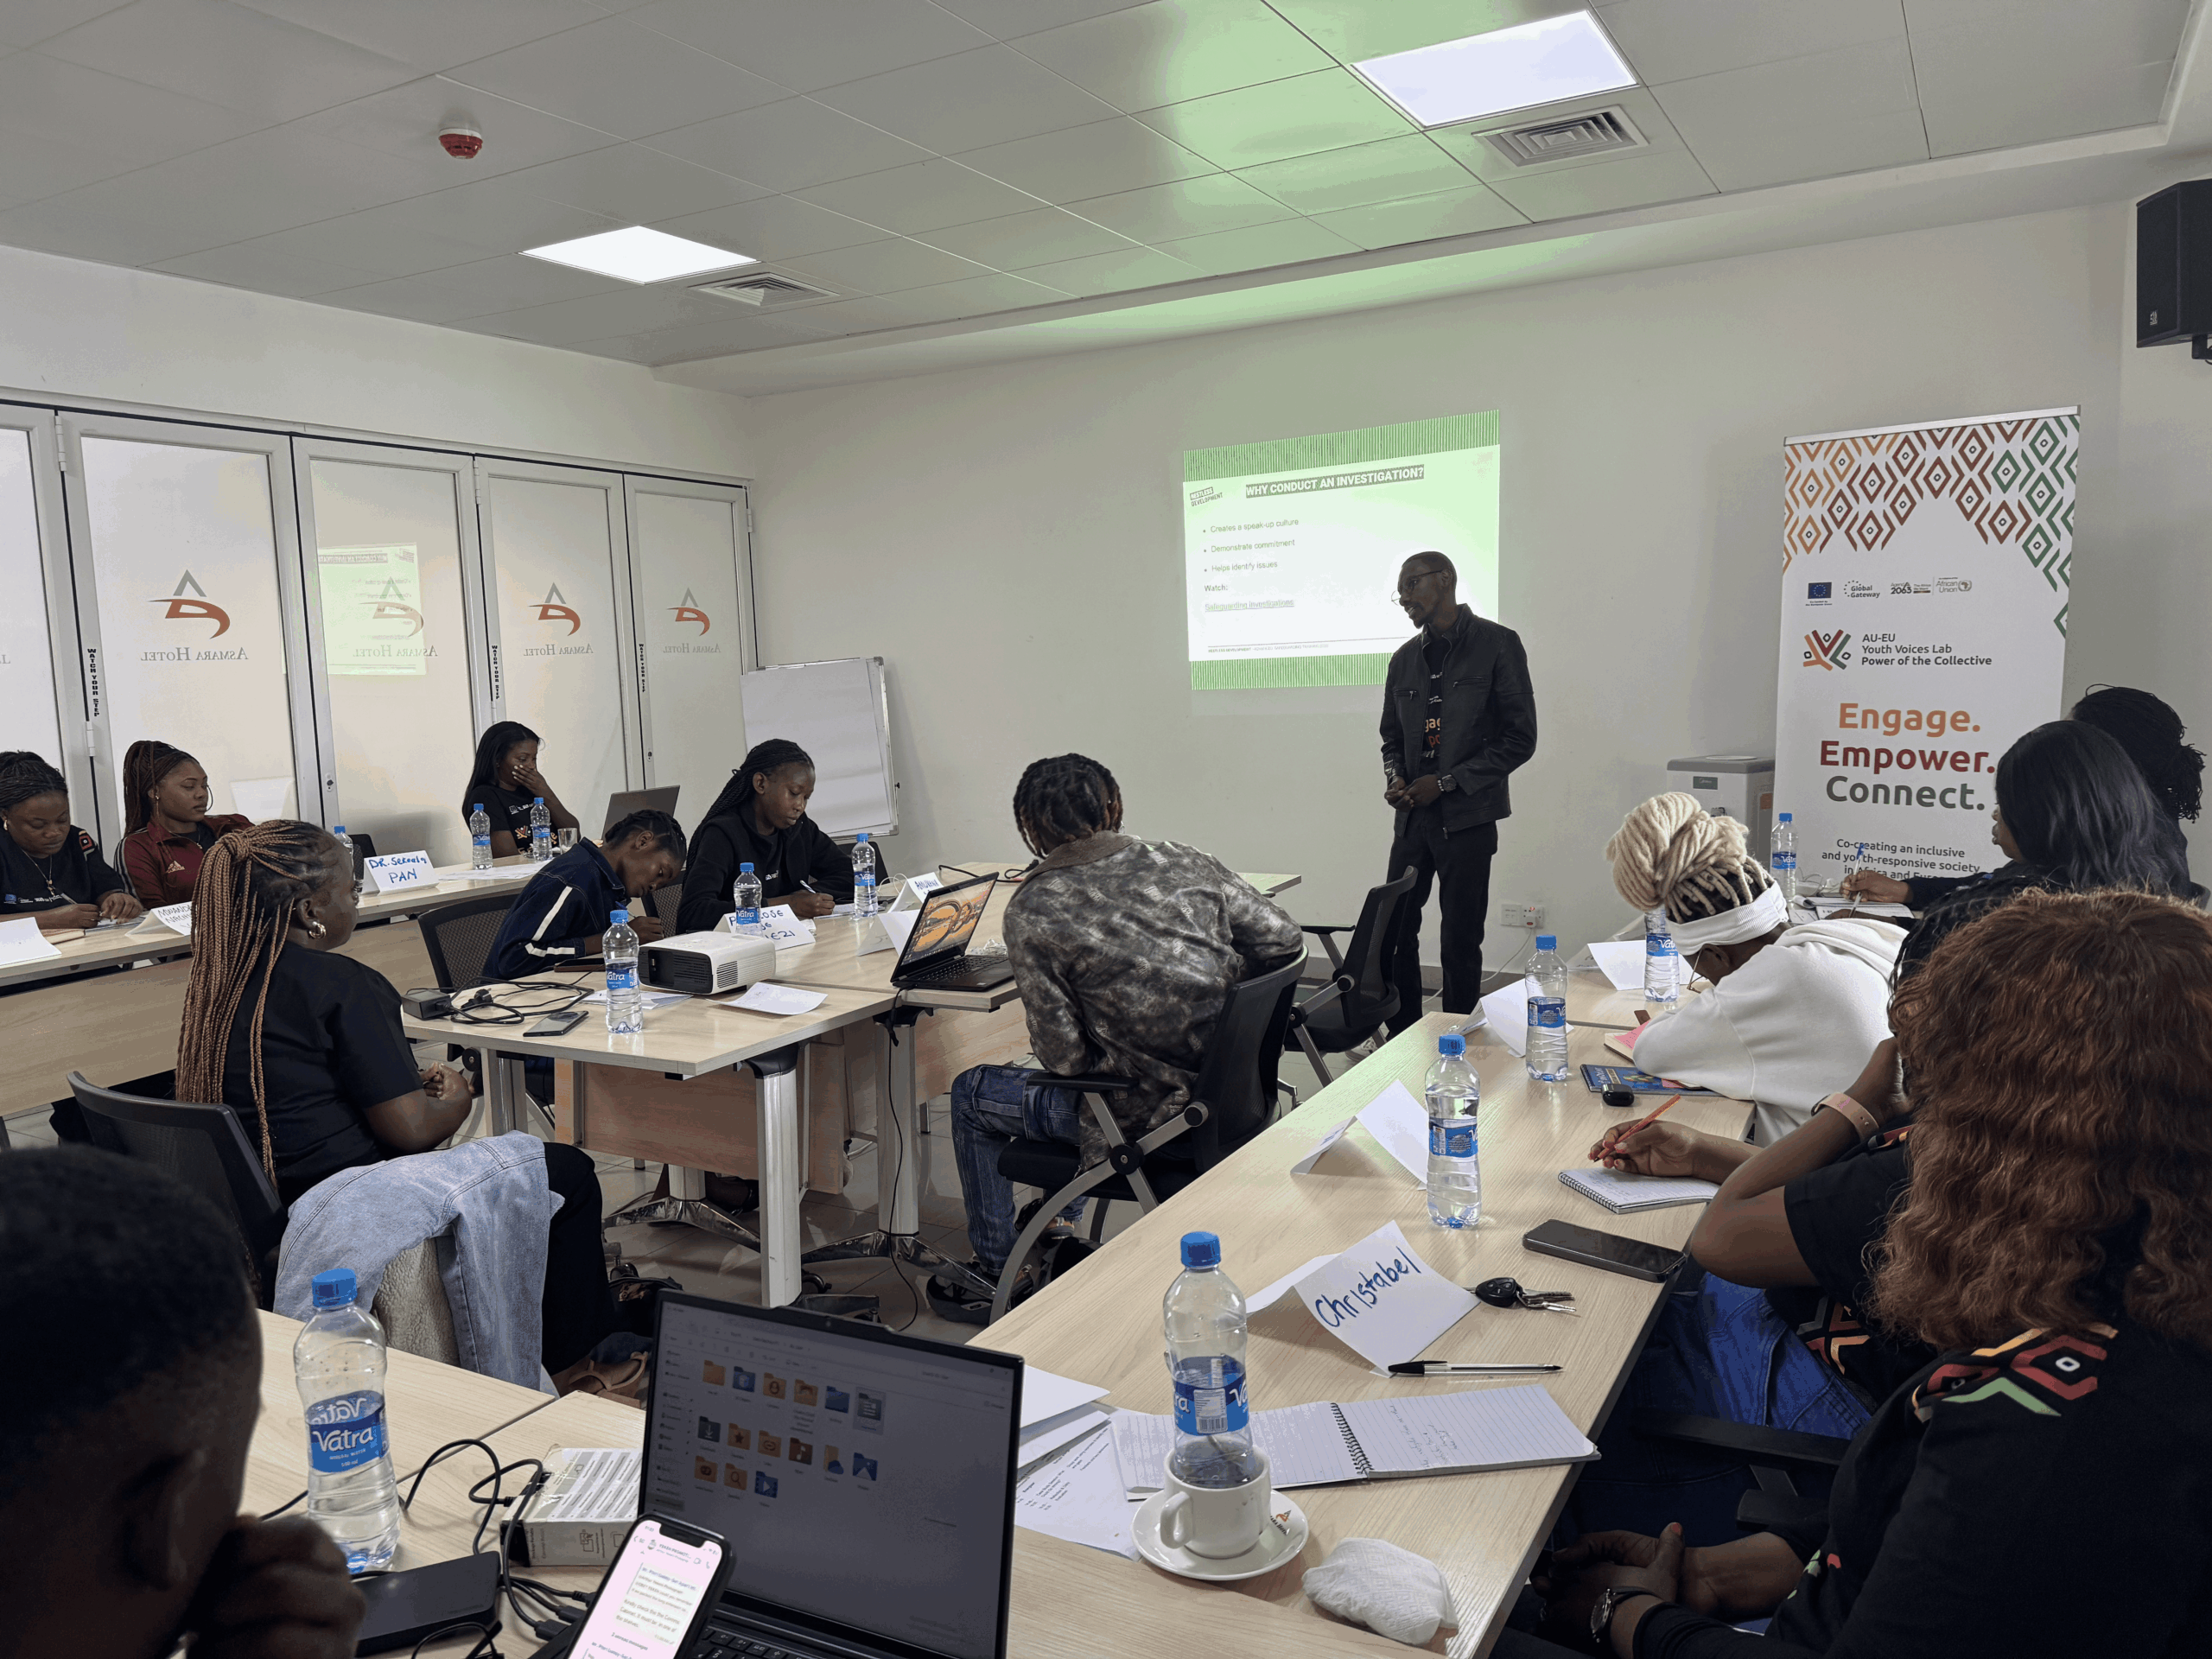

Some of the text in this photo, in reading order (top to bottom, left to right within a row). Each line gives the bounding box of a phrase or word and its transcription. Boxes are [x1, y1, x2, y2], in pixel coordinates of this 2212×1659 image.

[1246, 467, 1424, 496] WHY CONDUCT AN INVESTIGATION?
[1192, 493, 1223, 506] DEVELOPMENT
[1211, 524, 1236, 533] Creates
[1244, 521, 1274, 531] speak-up
[1211, 539, 1295, 552] Demonstrate commitment
[1211, 564, 1230, 573] Helps
[1232, 563, 1255, 571] identify
[1205, 601, 1248, 612] Safeguarding
[1862, 633, 1896, 642] AU-EU
[1862, 644, 1952, 654] Youth Voices Lab
[87, 648, 97, 673] WATCH
[1861, 656, 1993, 665] Power of the Collective
[1839, 702, 1980, 738] Engage.
[1820, 740, 1995, 774] Empower.
[1826, 775, 1985, 810] Connect.
[1916, 844, 1966, 858] inclusive
[1821, 851, 1980, 874] and yoth-responsive society
[389, 868, 417, 883] PAN
[1844, 865, 1853, 874] in
[1891, 870, 1910, 880] and
[736, 910, 754, 918] Vatra
[1315, 1245, 1421, 1327] Christabel
[312, 1427, 374, 1452] Vatra
